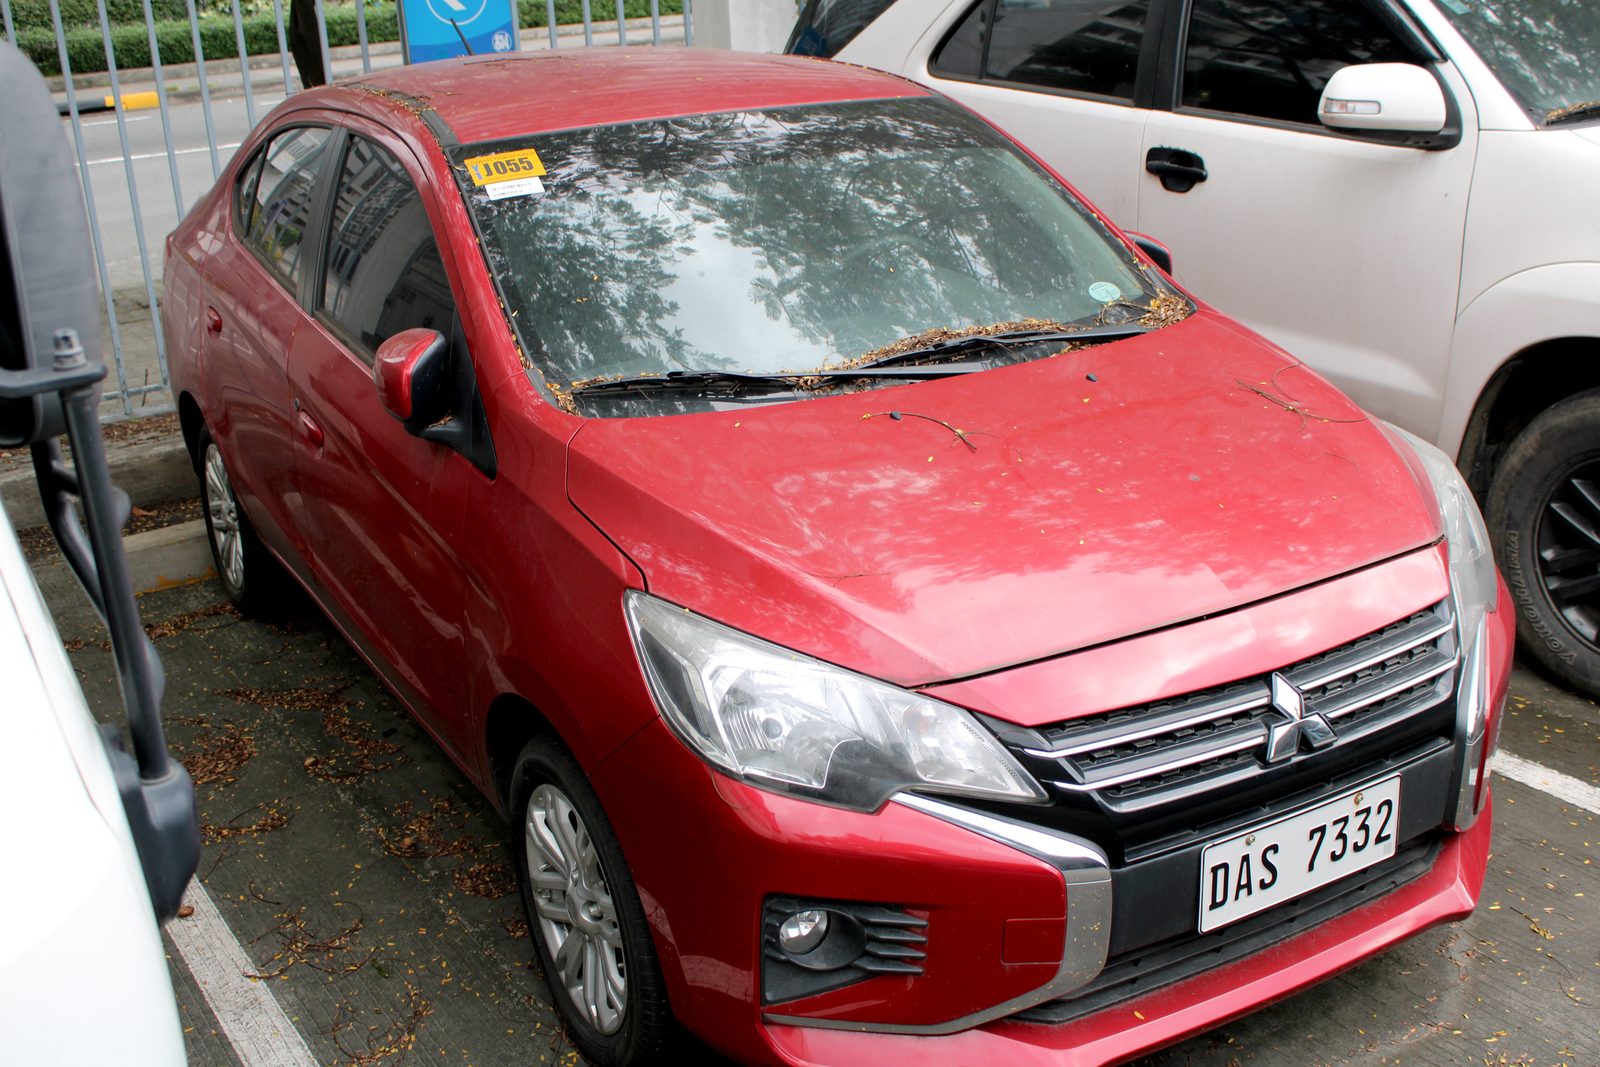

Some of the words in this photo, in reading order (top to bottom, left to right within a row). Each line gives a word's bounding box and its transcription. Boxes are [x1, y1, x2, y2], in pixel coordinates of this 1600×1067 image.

[483, 157, 533, 177] J055
[1506, 529, 1577, 666] YOKOHAMA
[1208, 843, 1279, 911] DAS
[1307, 798, 1393, 872] 7332
